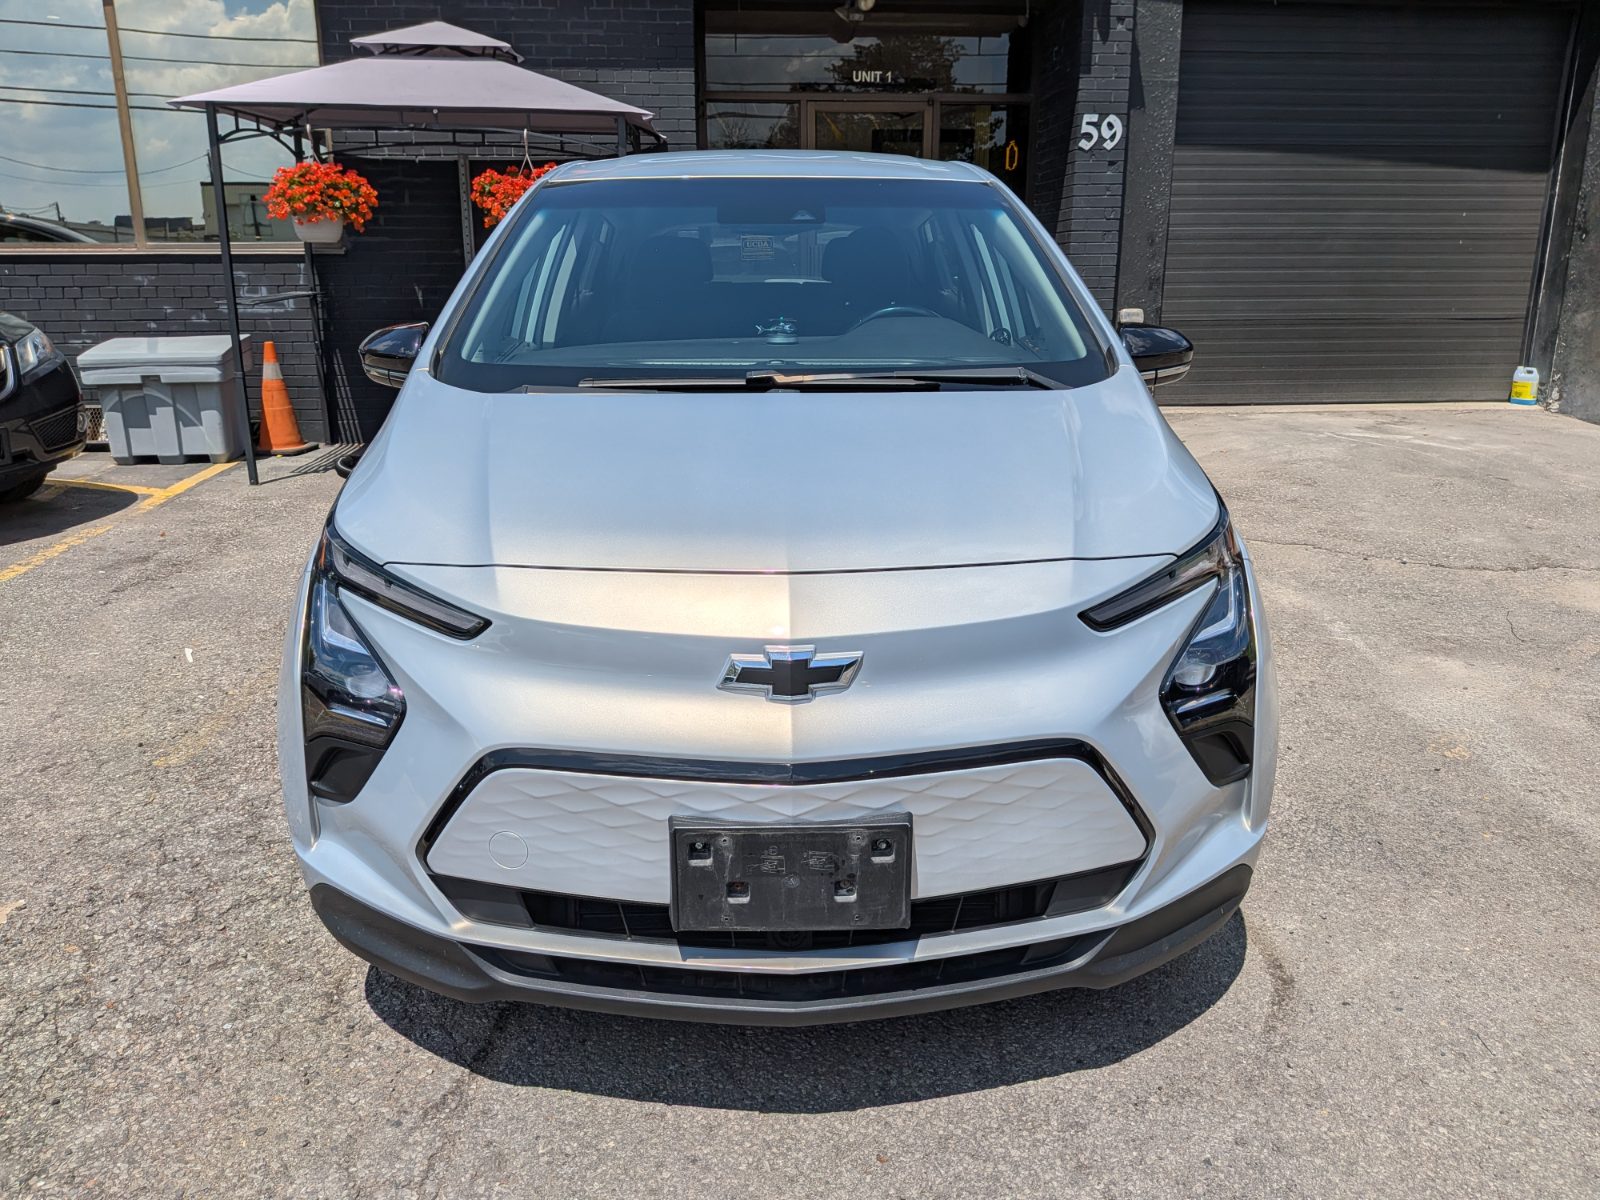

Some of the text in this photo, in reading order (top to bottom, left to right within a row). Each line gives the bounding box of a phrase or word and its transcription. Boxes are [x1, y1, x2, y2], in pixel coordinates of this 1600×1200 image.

[852, 70, 892, 83] UNIT 1
[1078, 113, 1123, 151] 59
